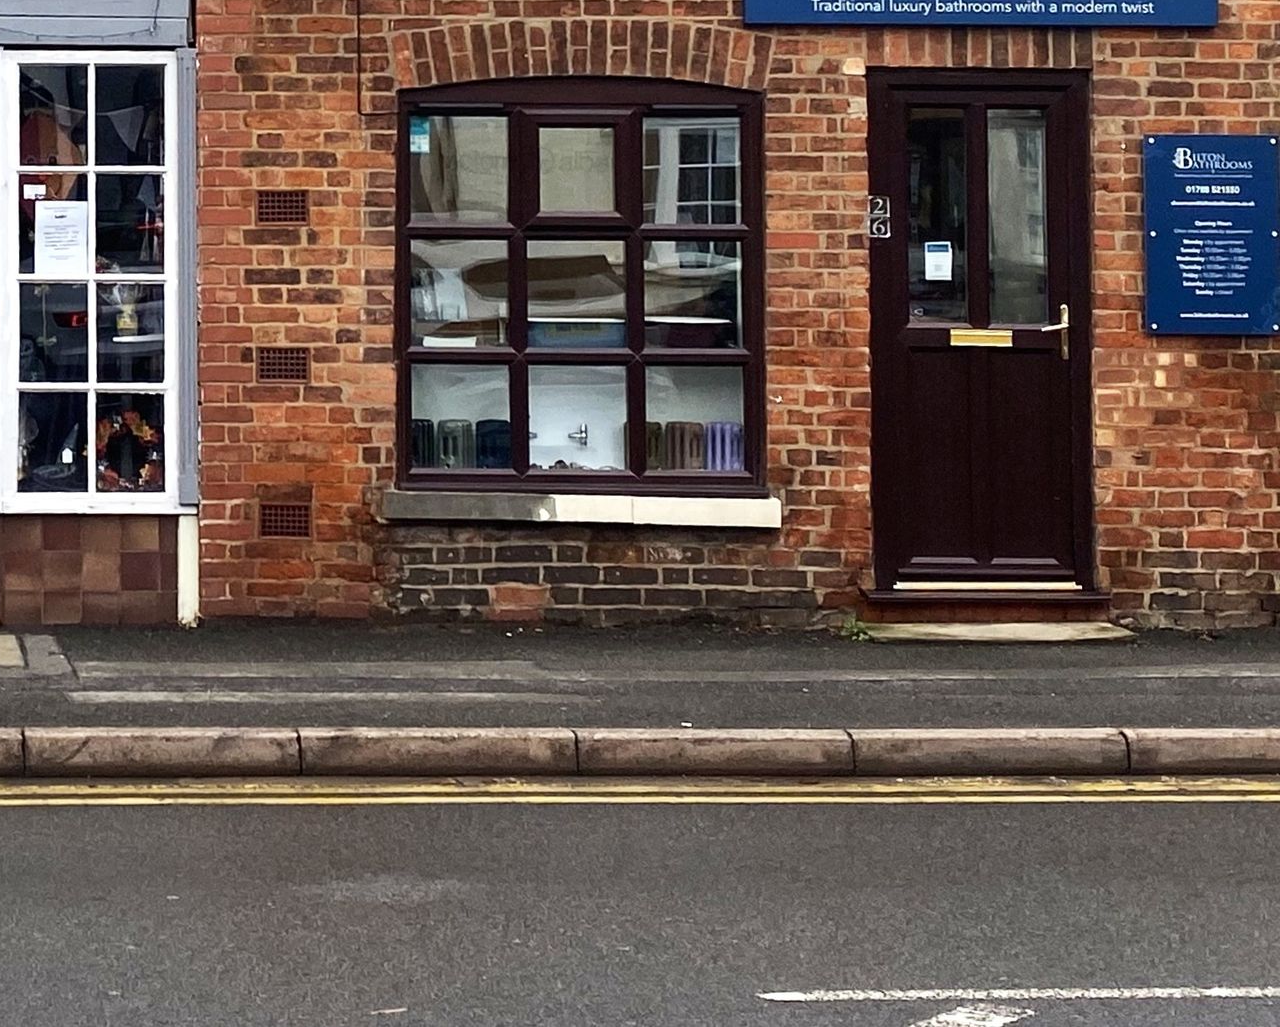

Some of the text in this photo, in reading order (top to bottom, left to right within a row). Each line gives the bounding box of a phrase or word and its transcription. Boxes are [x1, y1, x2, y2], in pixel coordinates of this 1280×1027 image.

[1048, 2, 1058, 14] a
[1061, 0, 1118, 14] modern
[1121, 0, 1155, 14] twist
